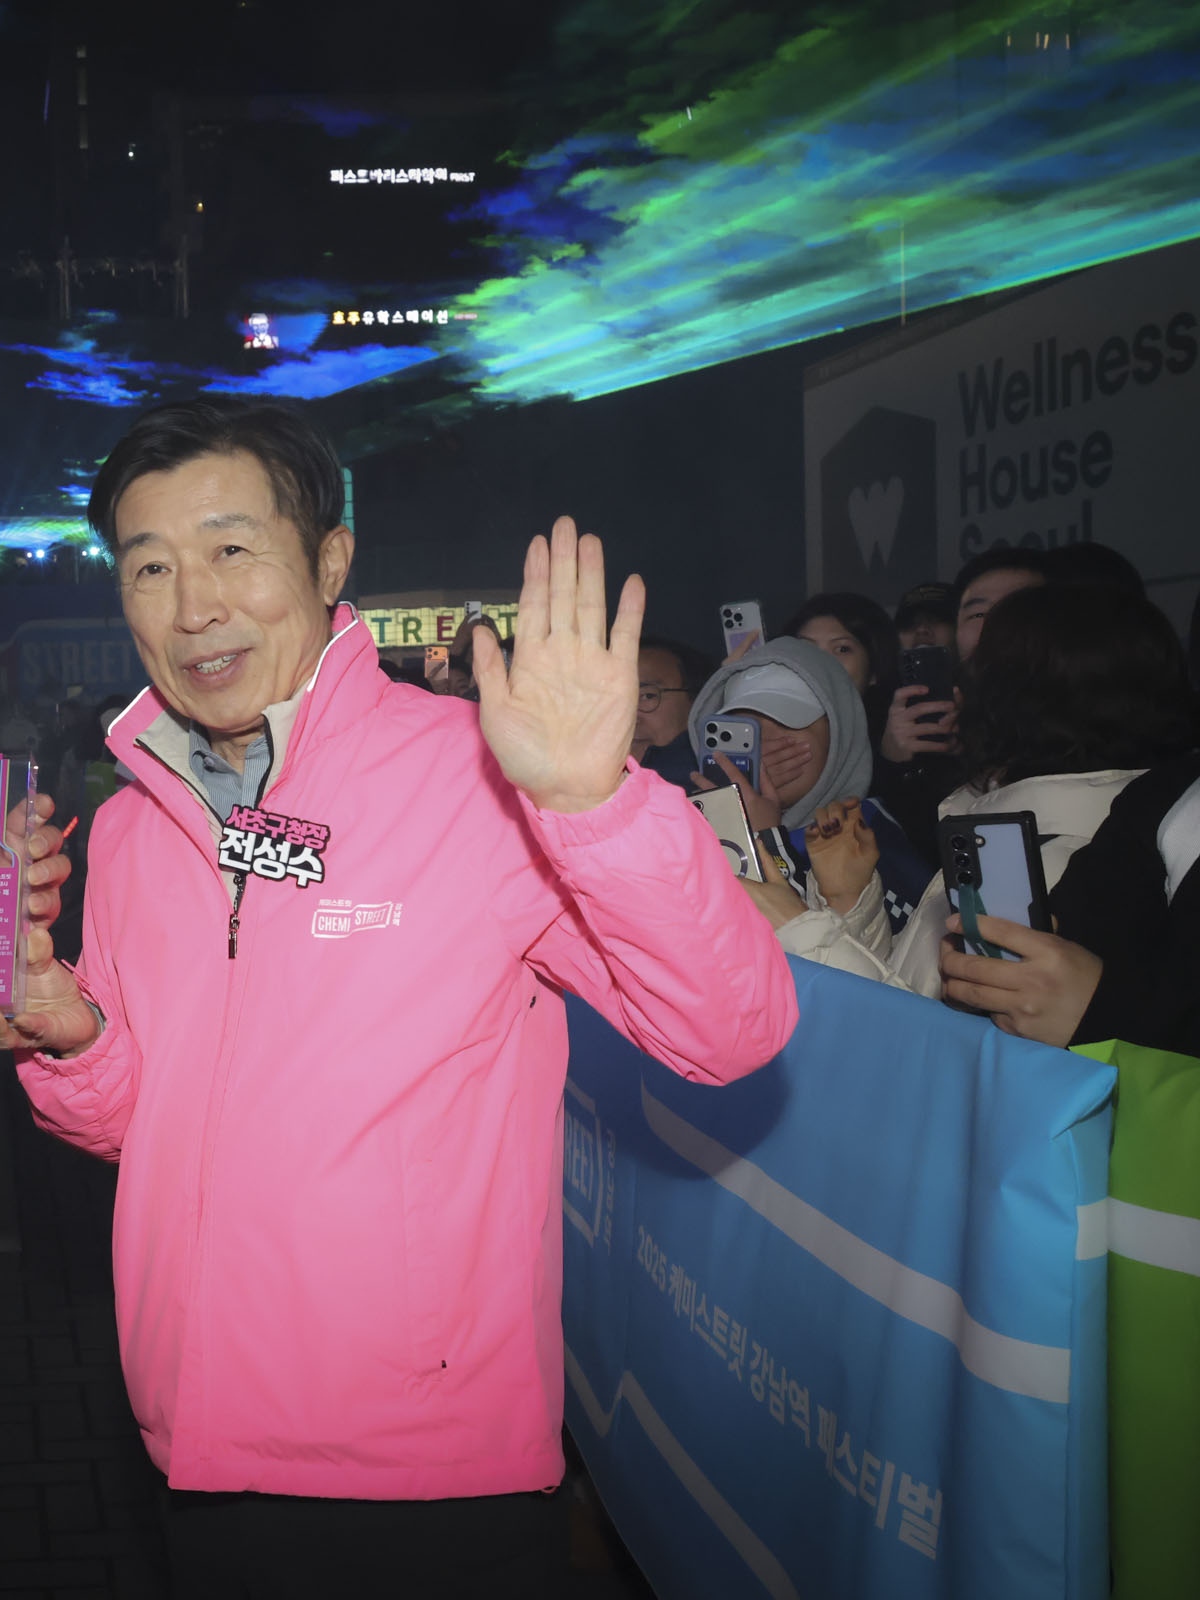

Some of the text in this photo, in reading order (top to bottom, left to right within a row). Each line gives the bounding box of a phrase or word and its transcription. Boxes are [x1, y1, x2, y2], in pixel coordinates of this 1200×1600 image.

[957, 311, 1199, 438] Wellness
[959, 430, 1113, 518] House
[371, 612, 518, 643] TRET
[218, 827, 323, 887] 전성수
[226, 806, 329, 849] 서초구청장
[318, 908, 387, 932] CHEMI STREET
[637, 1224, 943, 1561] 2025 케미스트릿 강남역 페스티벌
